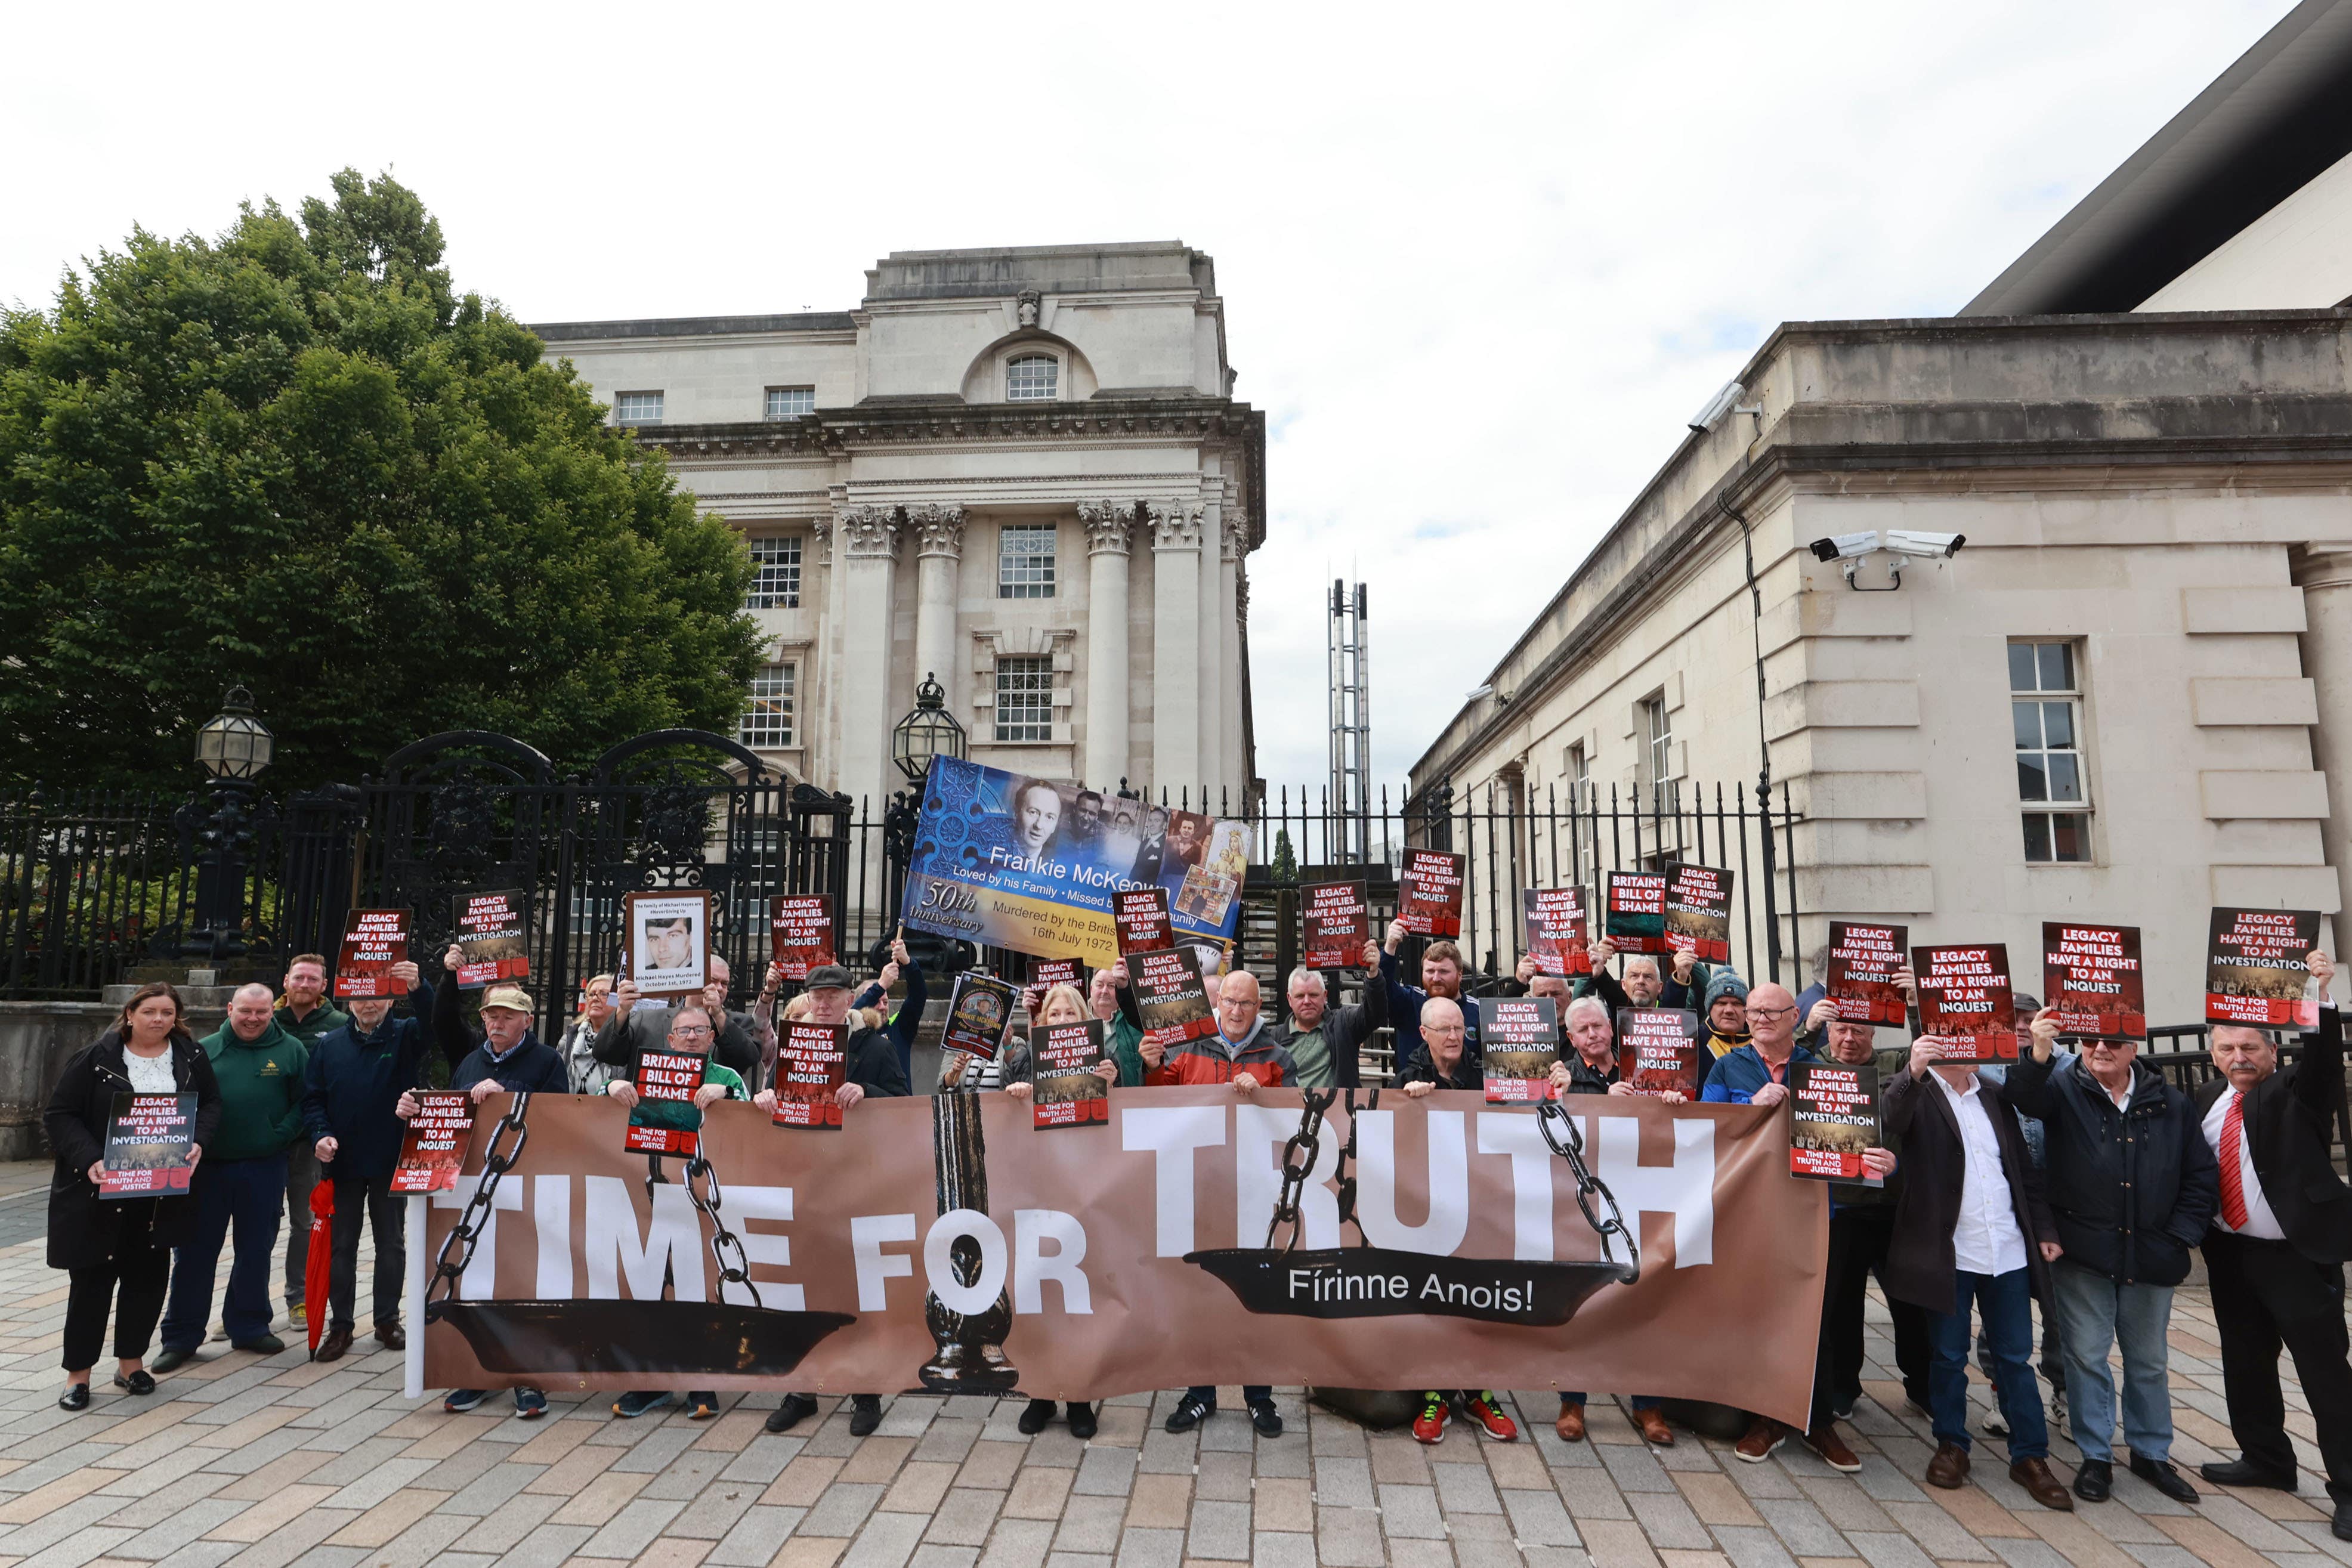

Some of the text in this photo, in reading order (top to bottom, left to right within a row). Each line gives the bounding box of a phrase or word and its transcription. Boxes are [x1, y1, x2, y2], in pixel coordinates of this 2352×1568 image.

[990, 846, 1066, 879] Frankie
[953, 865, 985, 882] Loved
[988, 874, 1002, 887] by
[1004, 877, 1019, 889] his
[1022, 881, 1058, 898] Family
[1067, 889, 1104, 907] Missed
[1107, 898, 1114, 911] b
[1315, 886, 1352, 898] LEGACY
[470, 896, 505, 907] LEGACY
[922, 881, 976, 912] 50th
[1314, 896, 1355, 908] FAMILIES
[469, 904, 508, 915] FAMILIES
[1306, 904, 1364, 918] HAVE A RIGHT
[461, 915, 481, 925] HAVE
[491, 912, 517, 921] RIGHT
[993, 901, 1116, 936] Murdered by the Britis
[1322, 916, 1349, 926] TO AN
[2237, 913, 2294, 925] LEGACY
[475, 922, 502, 932] TO AN
[1318, 925, 1355, 935] INQUEST
[2234, 924, 2294, 936] FAMILIES
[458, 929, 521, 942] INVESTIGATION
[1033, 926, 1112, 951] 16th July 1972
[2220, 934, 2307, 948] HAVE A RIGHT
[2242, 946, 2282, 957] TO AN
[2214, 955, 2310, 970] INVESTIGATION
[472, 973, 497, 982] JUSTICE
[2224, 995, 2267, 1006] TIME FOR
[1498, 1004, 1536, 1012] LEGACY
[2212, 1002, 2243, 1012] TRUTH
[954, 1010, 977, 1022] FRANKIE
[1497, 1013, 1539, 1022] FAMILIES
[2230, 1012, 2268, 1021] JUSTICE
[792, 1026, 832, 1039] LEGACY
[1488, 1023, 1549, 1032] HAVE A RIGHT
[1505, 1033, 1533, 1041] TO AN
[789, 1038, 833, 1050] FAMILIES
[1486, 1043, 1553, 1052] INVESTIGATION
[780, 1048, 843, 1062] HAVE A RIGHT
[642, 1054, 701, 1071] BRITAIN'S
[794, 1061, 823, 1072] TO AN
[646, 1070, 693, 1085] BILL OF
[787, 1072, 829, 1084] INQUEST
[1810, 1069, 1855, 1081] LEGACY
[1809, 1080, 1858, 1092] FAMILIES
[645, 1085, 689, 1100] SHAME
[1798, 1090, 1869, 1104] HAVE A RIGHT
[134, 1097, 177, 1106] LEGACY
[1818, 1102, 1849, 1113] TO AN
[130, 1107, 177, 1115] FAMILIES
[119, 1117, 145, 1125] HAVE
[156, 1116, 186, 1124] RIGHT
[784, 1115, 809, 1124] JUSTICE
[1795, 1111, 1874, 1126] INVESTIGATION
[136, 1126, 166, 1134] TO AN
[112, 1134, 187, 1145] INVESTIGATION
[1796, 1156, 1821, 1165] TRUTH
[1810, 1165, 1841, 1175] JUSTICE
[433, 1103, 1716, 1317] TIME FOR TRUTH
[1289, 1269, 1533, 1312] Fírinne Anois!
